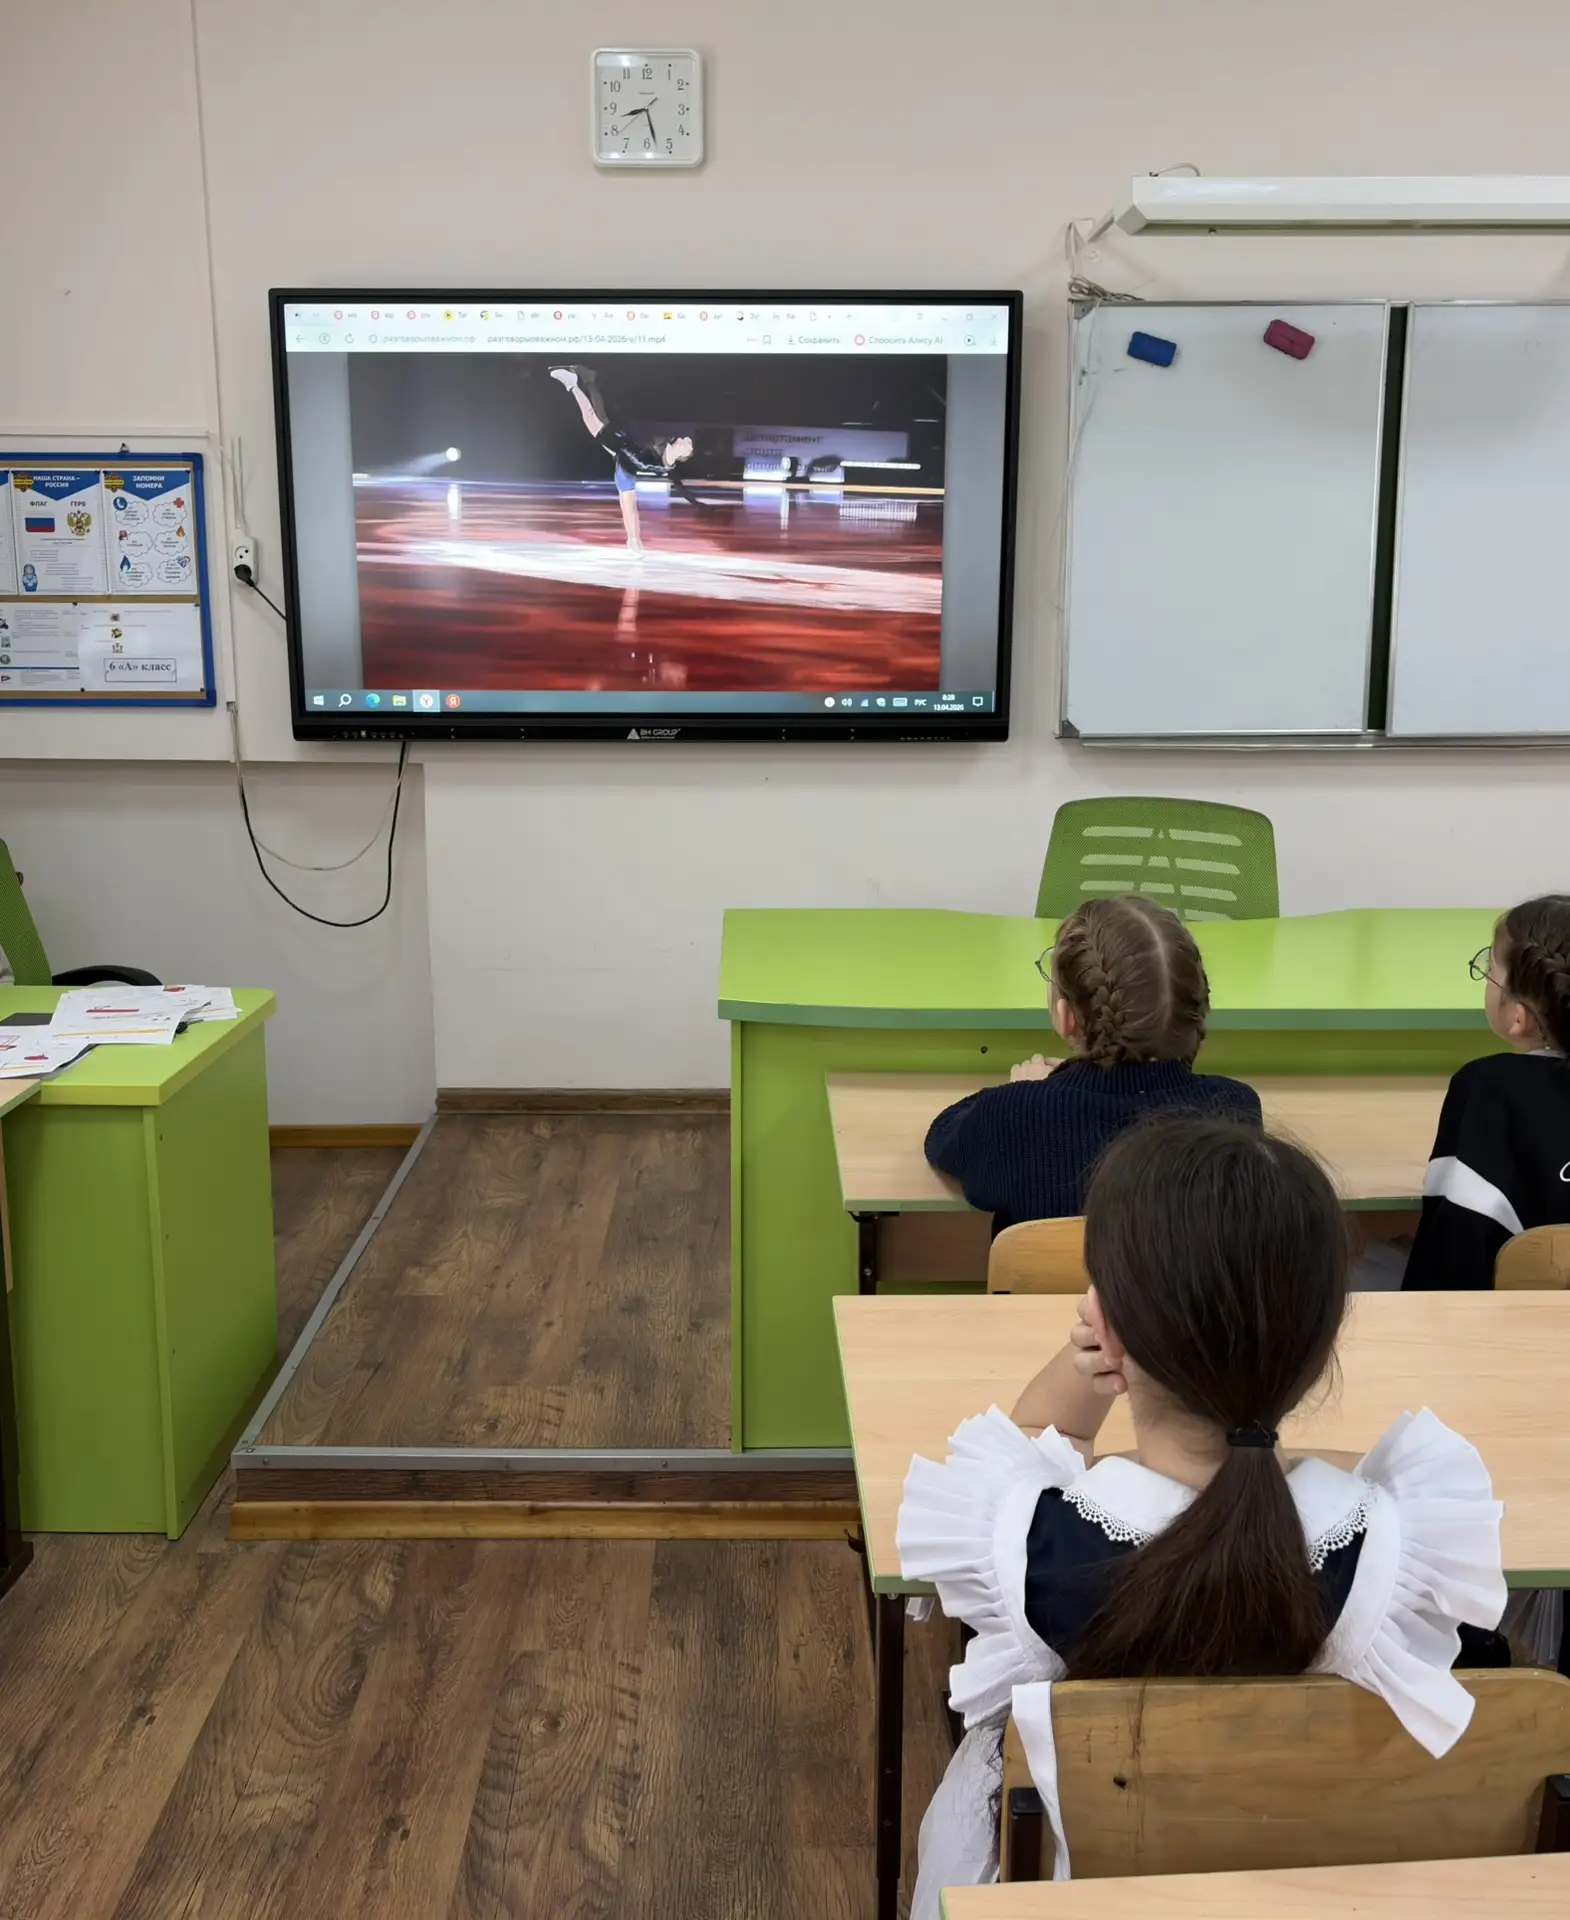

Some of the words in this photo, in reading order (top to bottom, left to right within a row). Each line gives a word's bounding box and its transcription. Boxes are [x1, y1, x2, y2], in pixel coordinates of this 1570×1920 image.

[623, 68, 631, 80] 11
[641, 68, 653, 80] 12
[610, 81, 621, 93] 10
[677, 79, 684, 91] 2
[610, 102, 617, 115] 9
[678, 104, 685, 116] 3
[611, 124, 620, 136] 8
[679, 124, 685, 136] 4
[623, 138, 630, 149] 7
[644, 138, 651, 149] 6
[666, 138, 673, 150] 5
[868, 335, 907, 345] Спросить
[908, 335, 934, 345] Алису
[109, 662, 116, 671] 6
[118, 662, 139, 671] «А»
[141, 662, 172, 671] класс
[652, 728, 678, 736] GROUP
